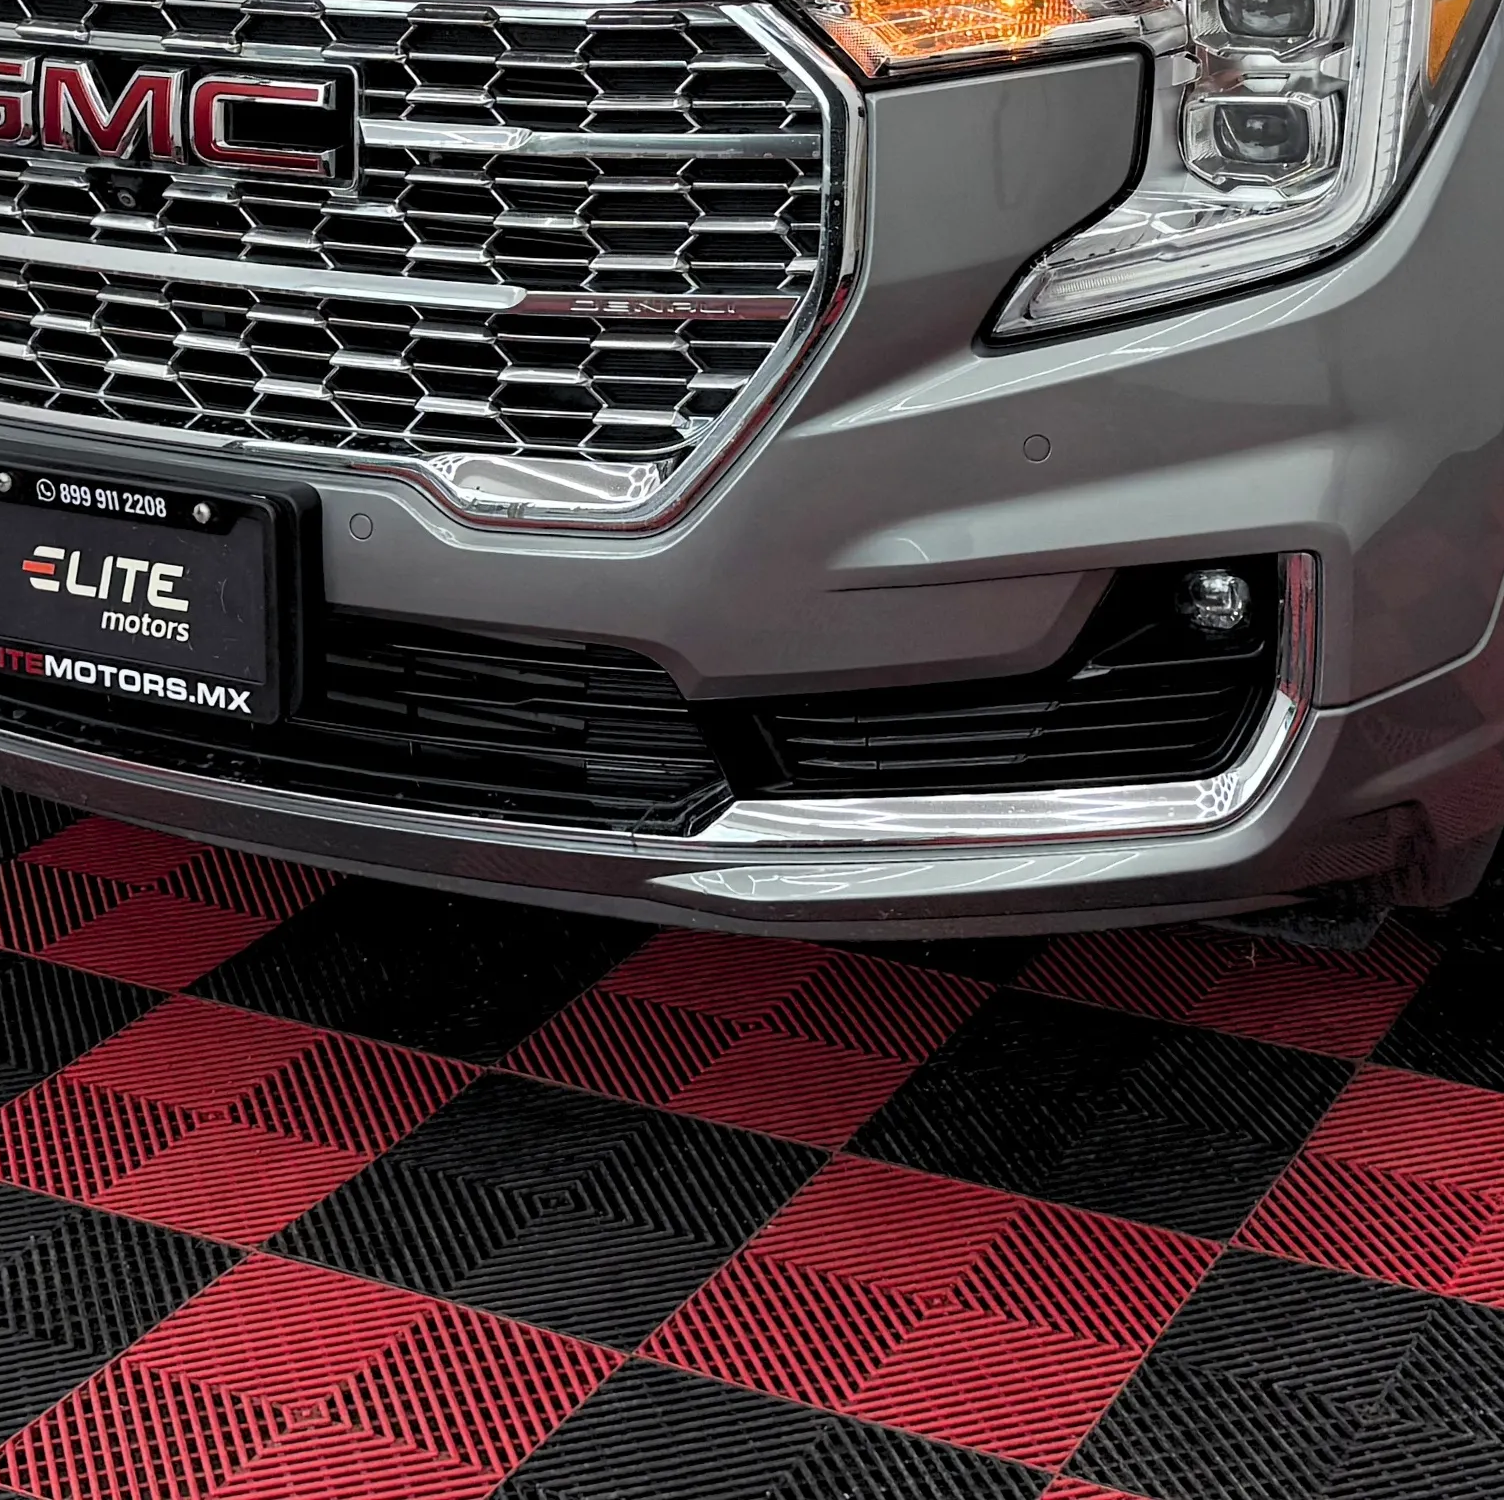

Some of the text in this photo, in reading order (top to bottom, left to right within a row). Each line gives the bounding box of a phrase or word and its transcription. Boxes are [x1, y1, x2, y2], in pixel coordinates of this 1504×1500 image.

[59, 482, 167, 518] 899 911 2208
[22, 545, 190, 612] ELITE
[100, 609, 191, 642] motors
